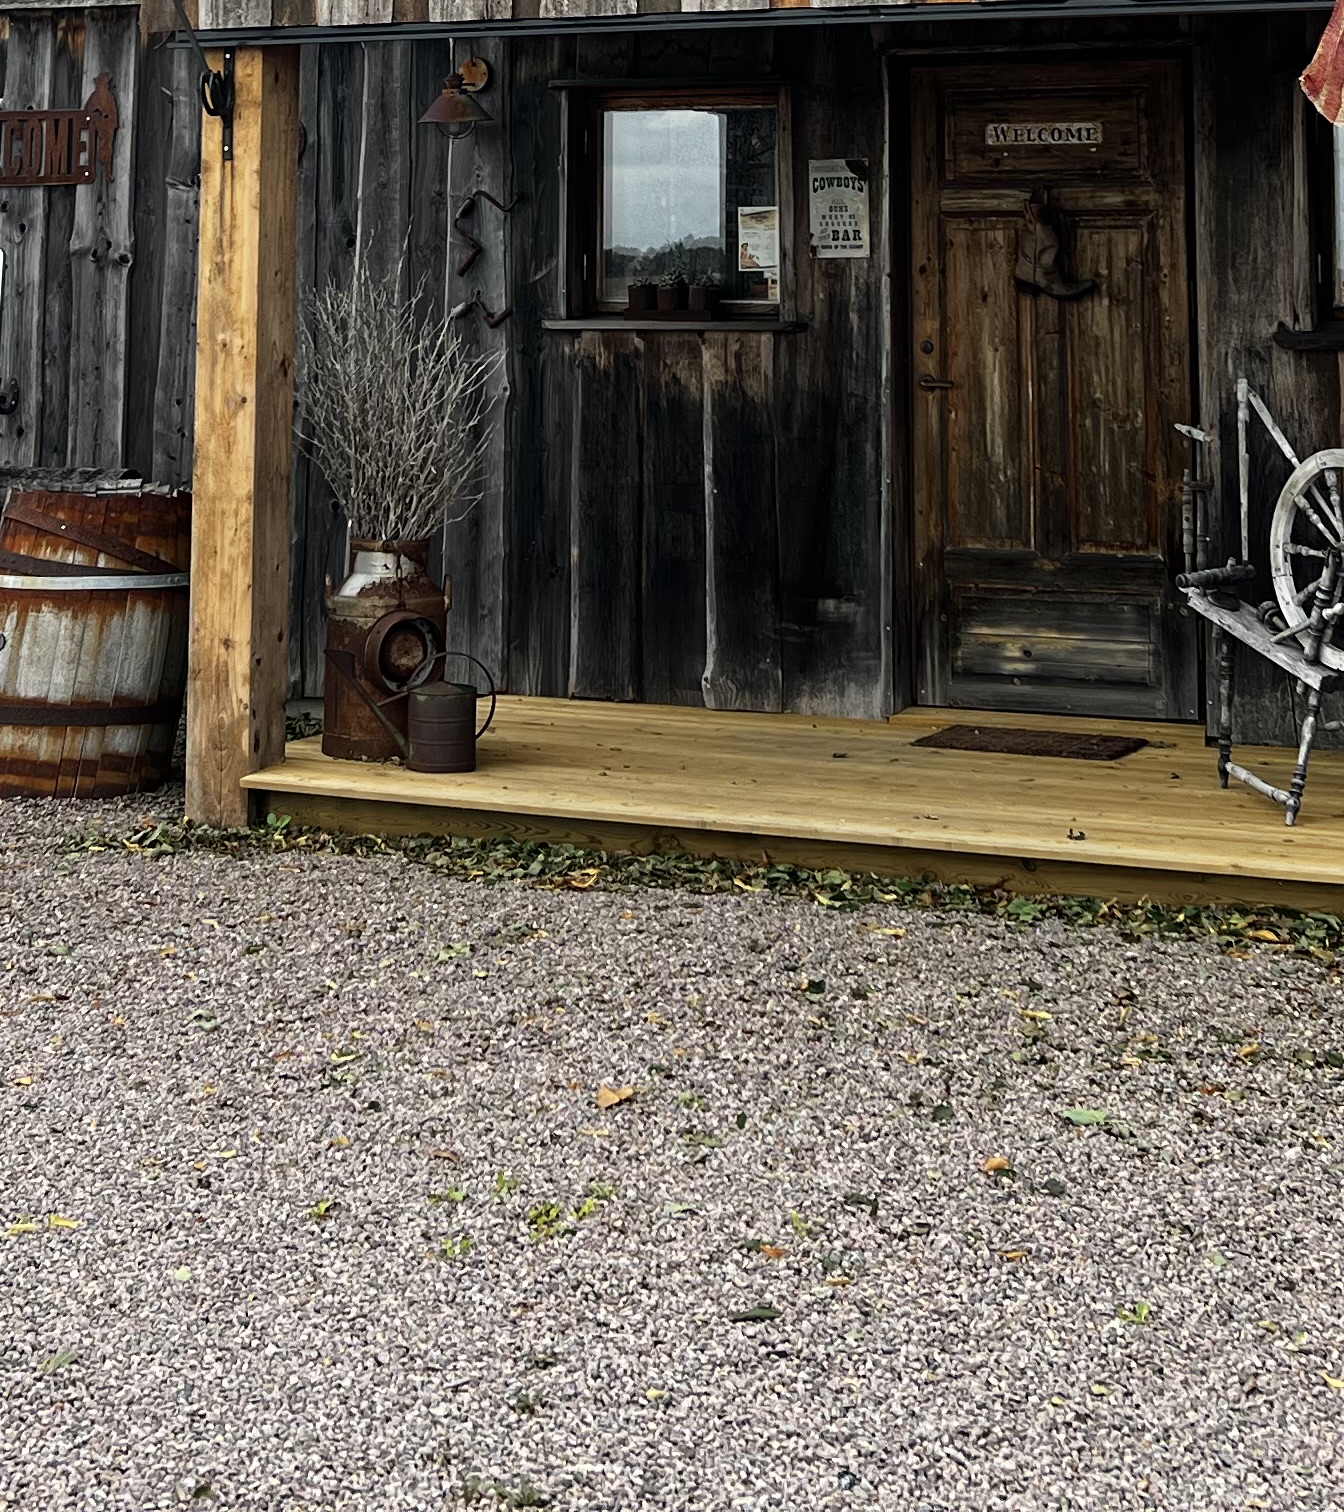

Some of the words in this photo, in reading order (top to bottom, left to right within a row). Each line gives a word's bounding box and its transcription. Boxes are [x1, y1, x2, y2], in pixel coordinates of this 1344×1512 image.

[992, 126, 1097, 143] WELCOME
[812, 176, 864, 194] COWBOYS
[831, 229, 862, 241] BAR
